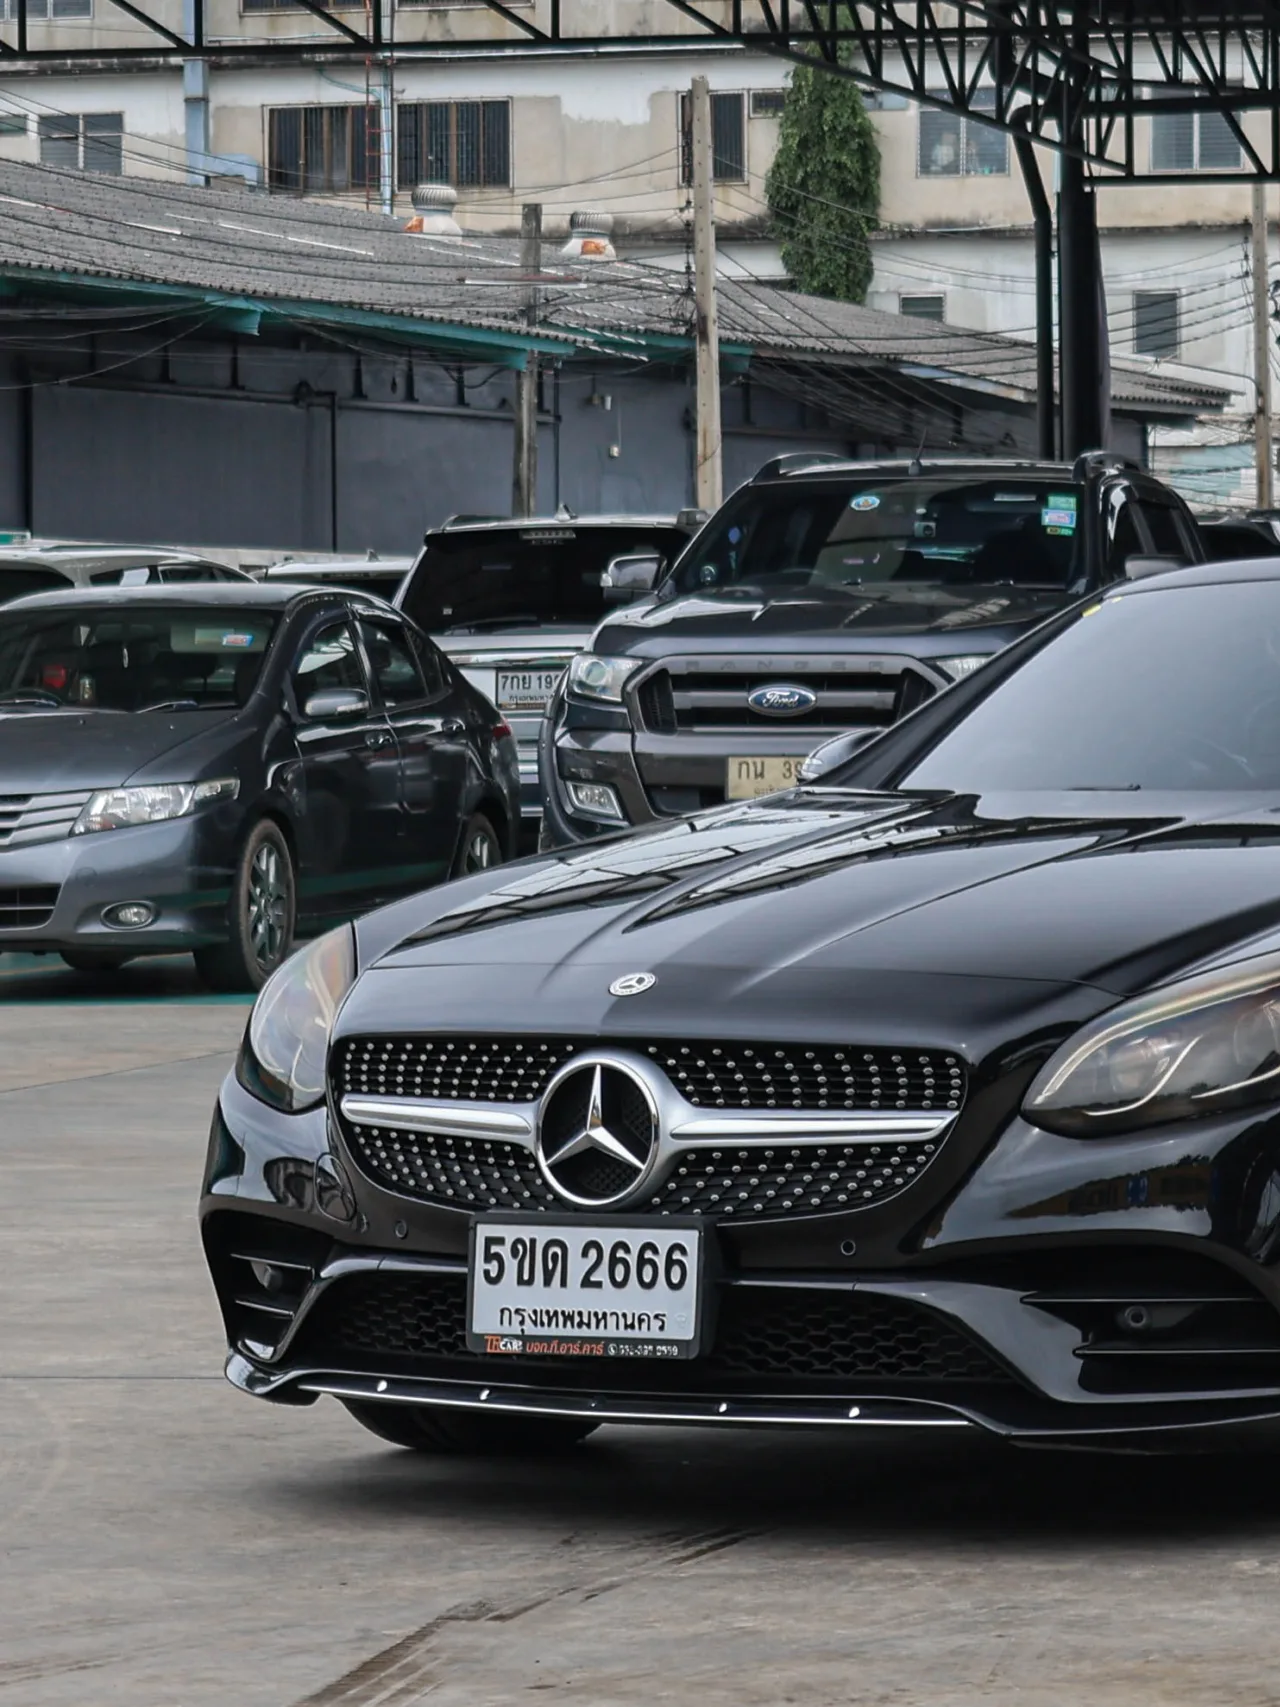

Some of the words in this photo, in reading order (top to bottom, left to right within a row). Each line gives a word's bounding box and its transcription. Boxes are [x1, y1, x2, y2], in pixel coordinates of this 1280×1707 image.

[762, 691, 800, 708] Ford
[737, 760, 765, 779] กน
[579, 1239, 689, 1291] 2666
[498, 1305, 667, 1335] กรุงเทพมหานคร
